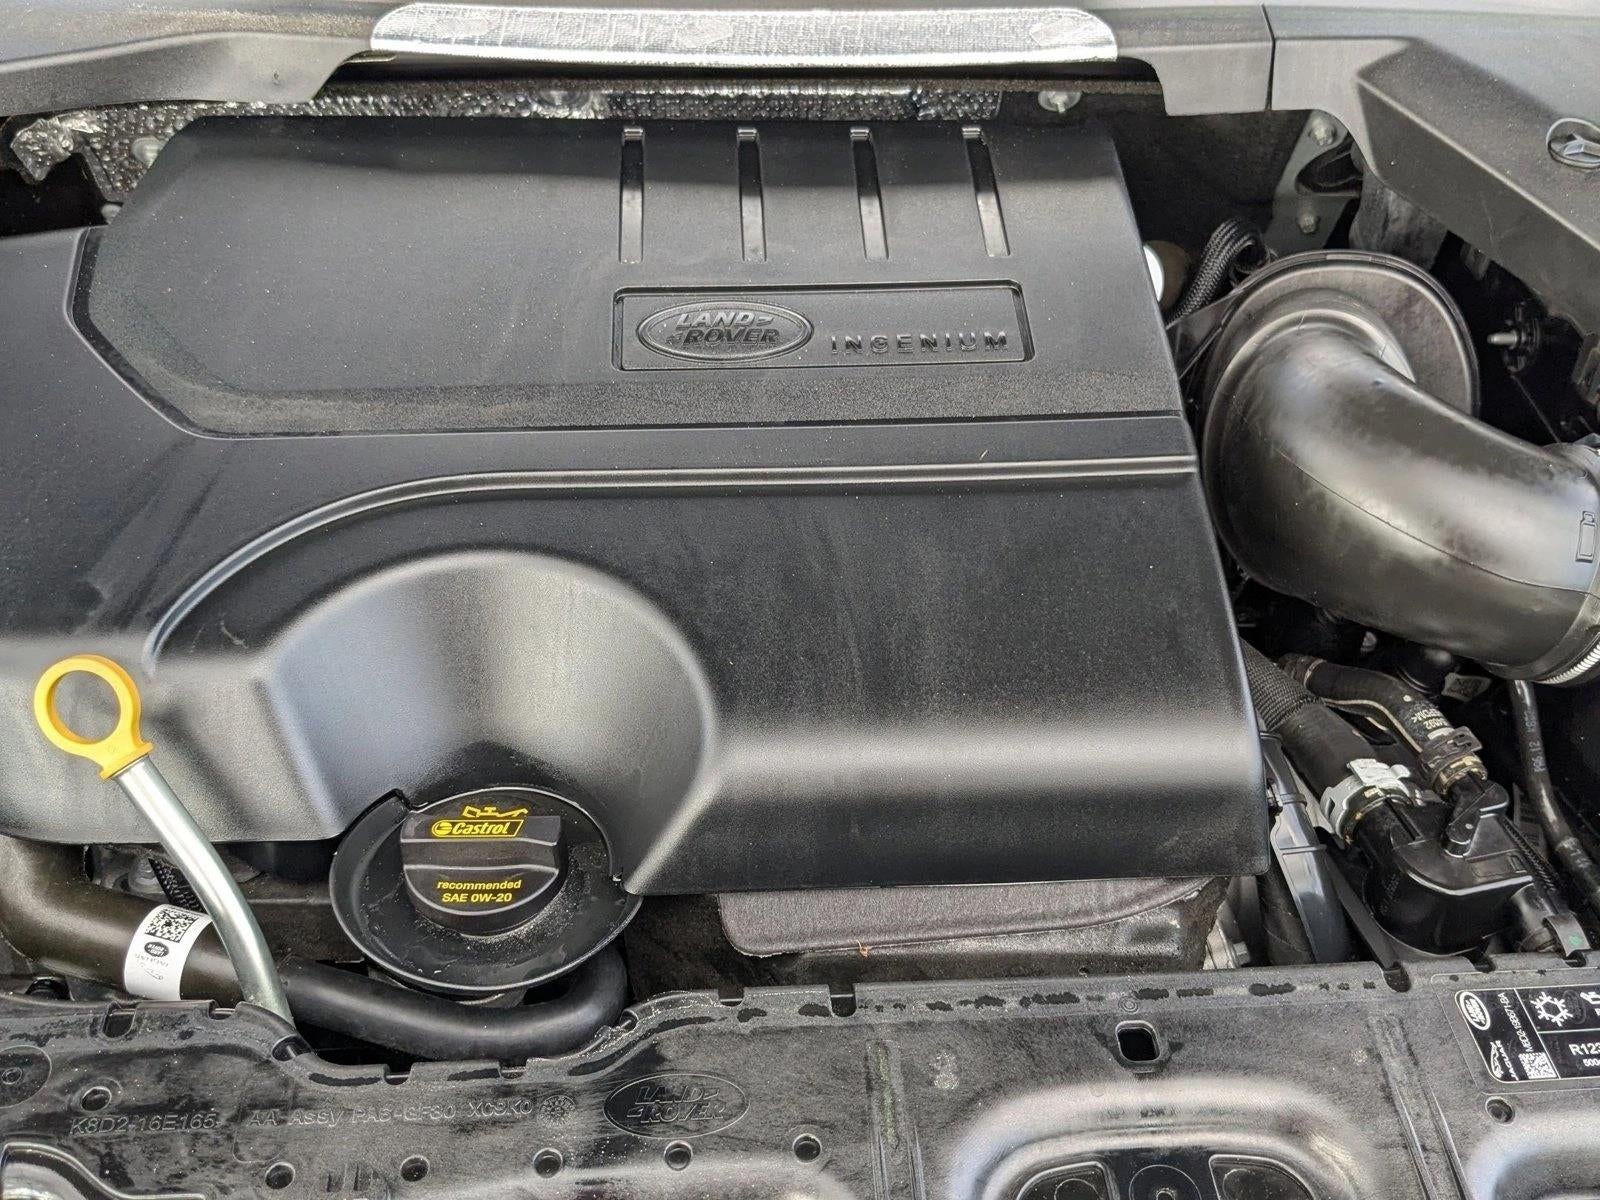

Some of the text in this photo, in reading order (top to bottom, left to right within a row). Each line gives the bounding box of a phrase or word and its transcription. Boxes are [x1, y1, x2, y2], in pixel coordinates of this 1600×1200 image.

[675, 311, 757, 330] LAND
[682, 328, 780, 347] ROVER
[830, 331, 1009, 353] INGENIUM
[452, 821, 511, 835] Castrol
[437, 879, 522, 891] recommended
[442, 892, 513, 903] SAE 0W-20
[1495, 1040, 1519, 1081] JAGUAR
